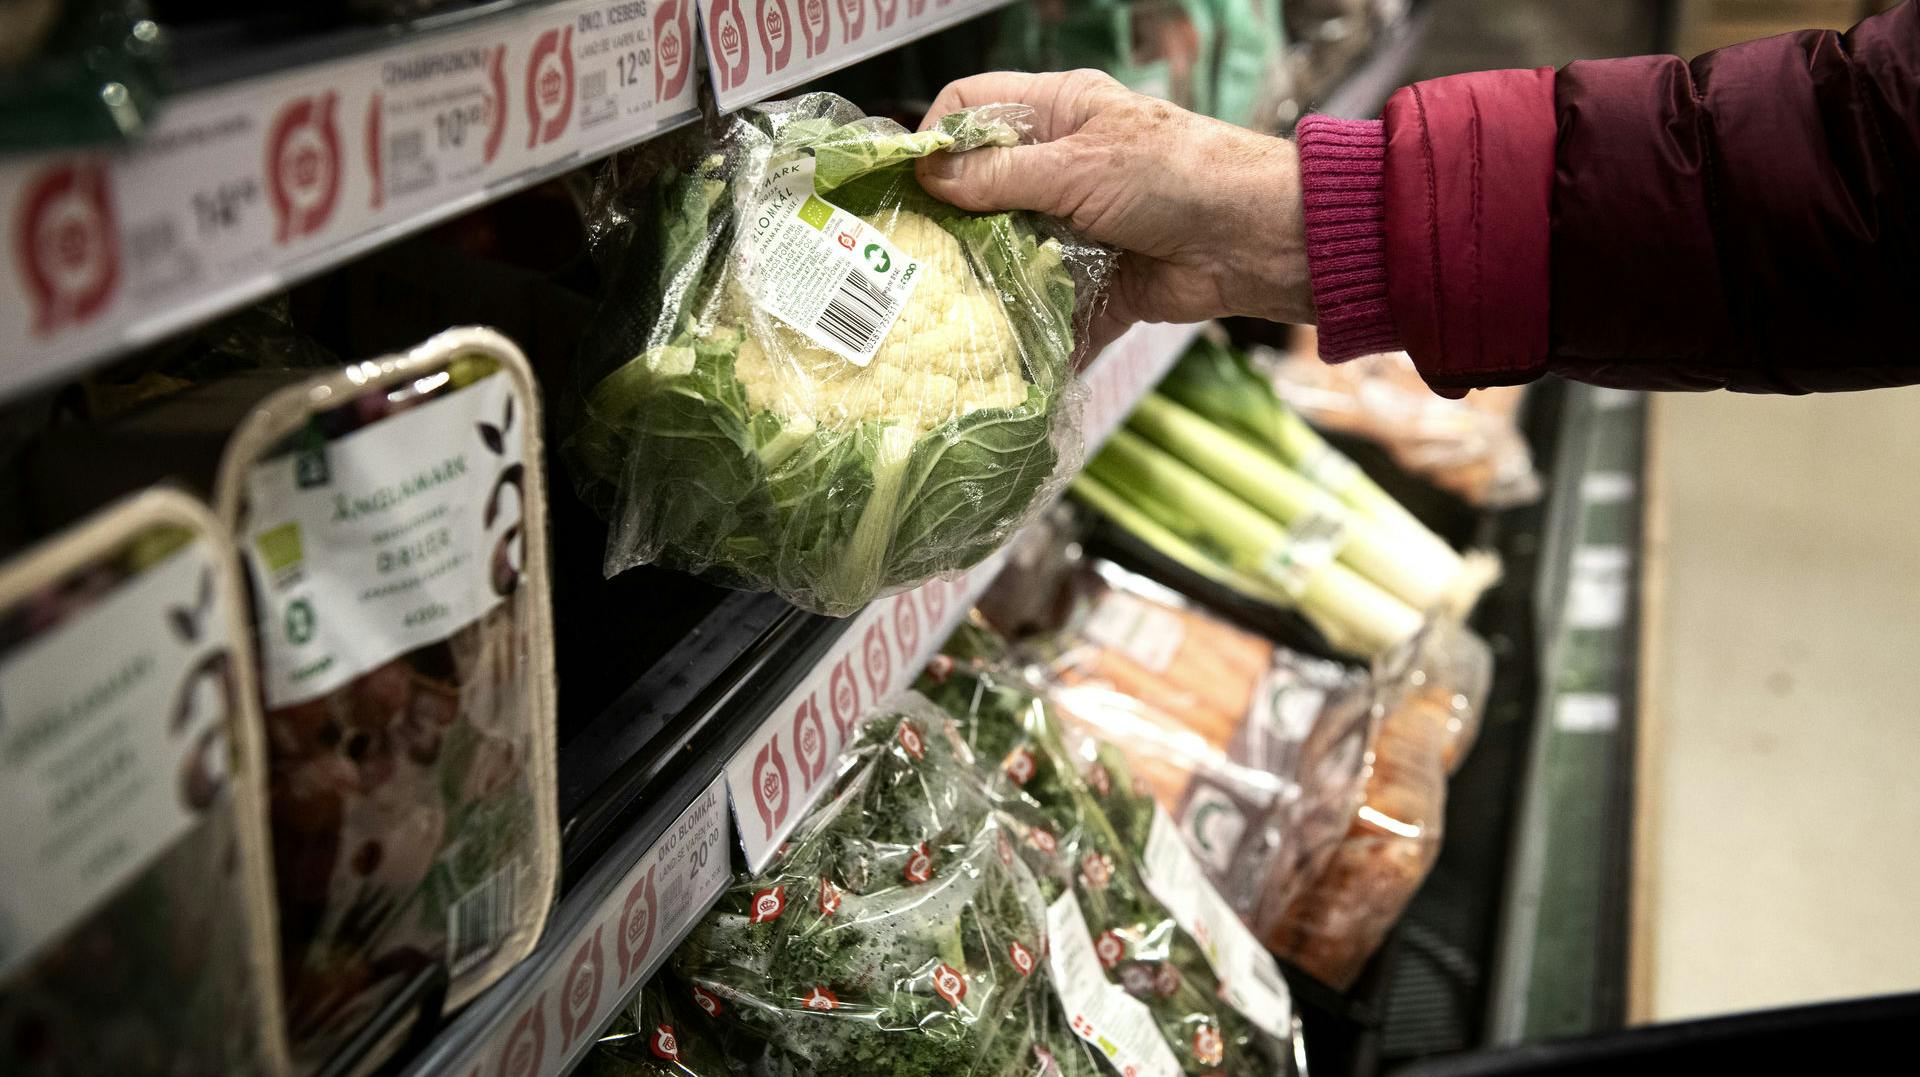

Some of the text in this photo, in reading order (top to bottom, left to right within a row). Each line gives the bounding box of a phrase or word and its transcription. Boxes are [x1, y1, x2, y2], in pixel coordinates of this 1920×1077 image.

[757, 185, 779, 208] OGISK
[758, 218, 785, 253] DANMARK
[658, 834, 677, 861] ØKO
